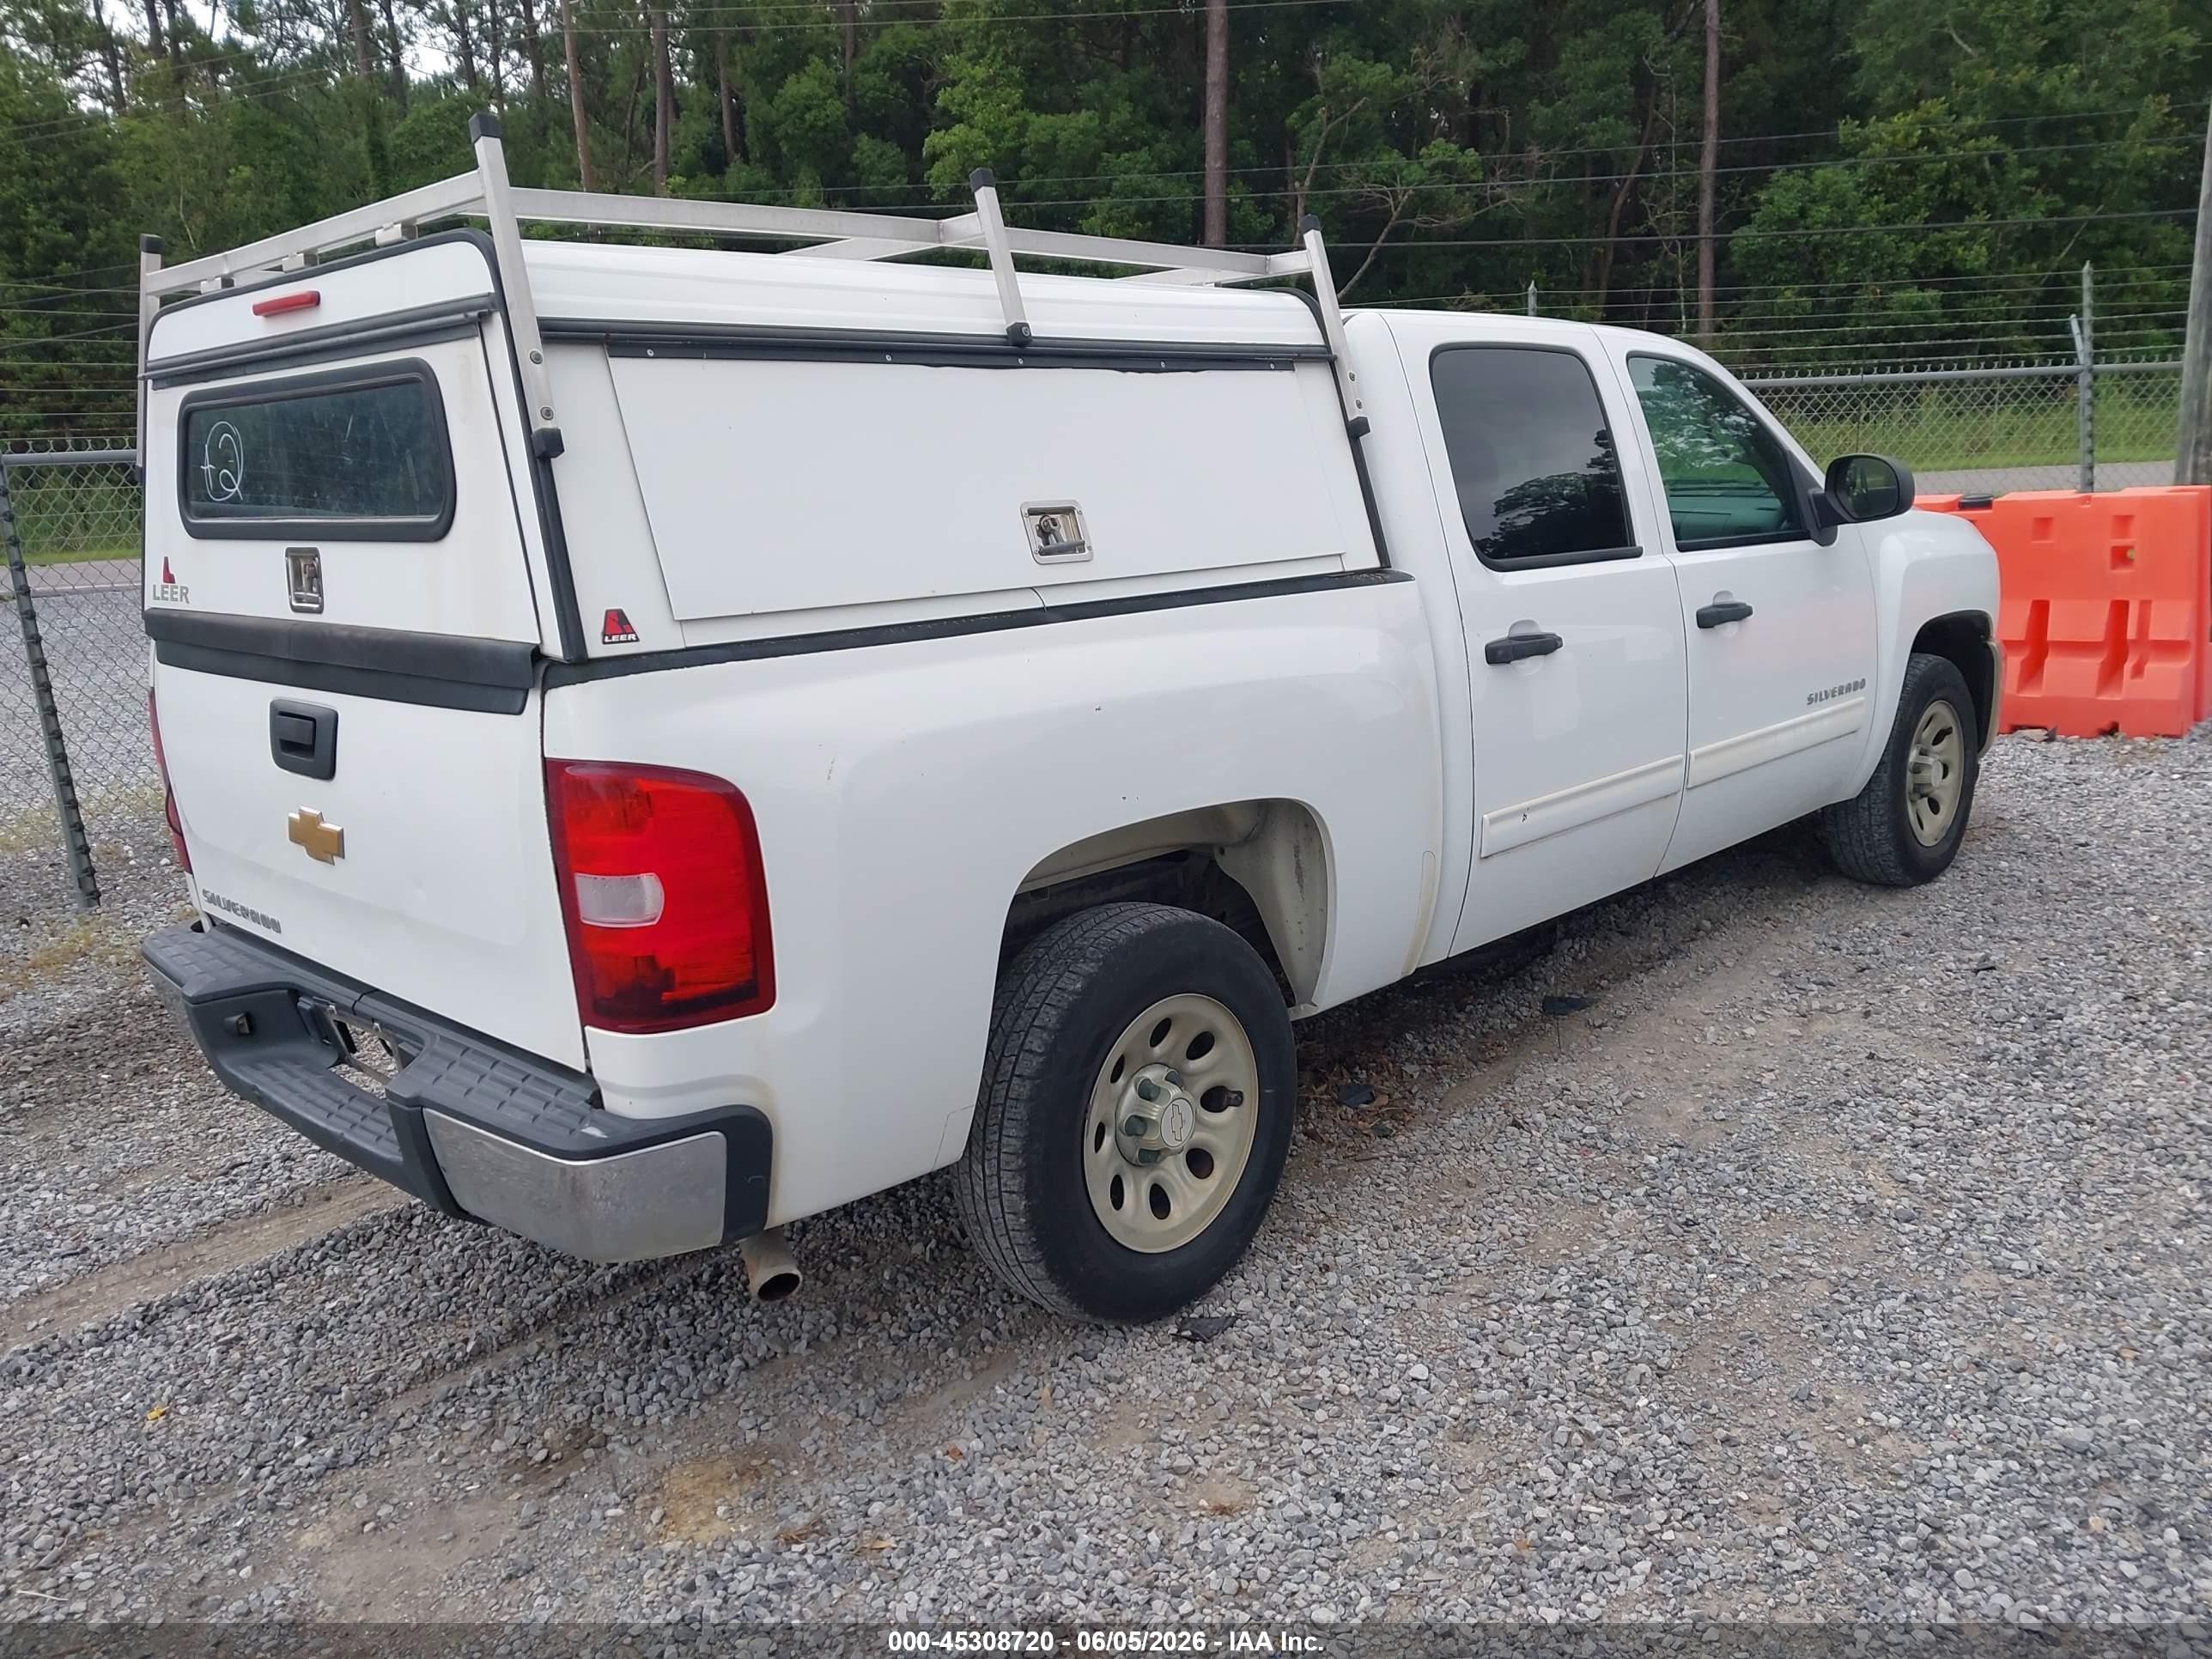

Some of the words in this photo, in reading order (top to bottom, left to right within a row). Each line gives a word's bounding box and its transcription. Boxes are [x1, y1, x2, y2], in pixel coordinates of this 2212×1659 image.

[153, 584, 190, 605] LEER
[604, 634, 637, 642] LEER
[1806, 678, 1867, 706] SILVERADO
[202, 888, 282, 934] SILVERADO
